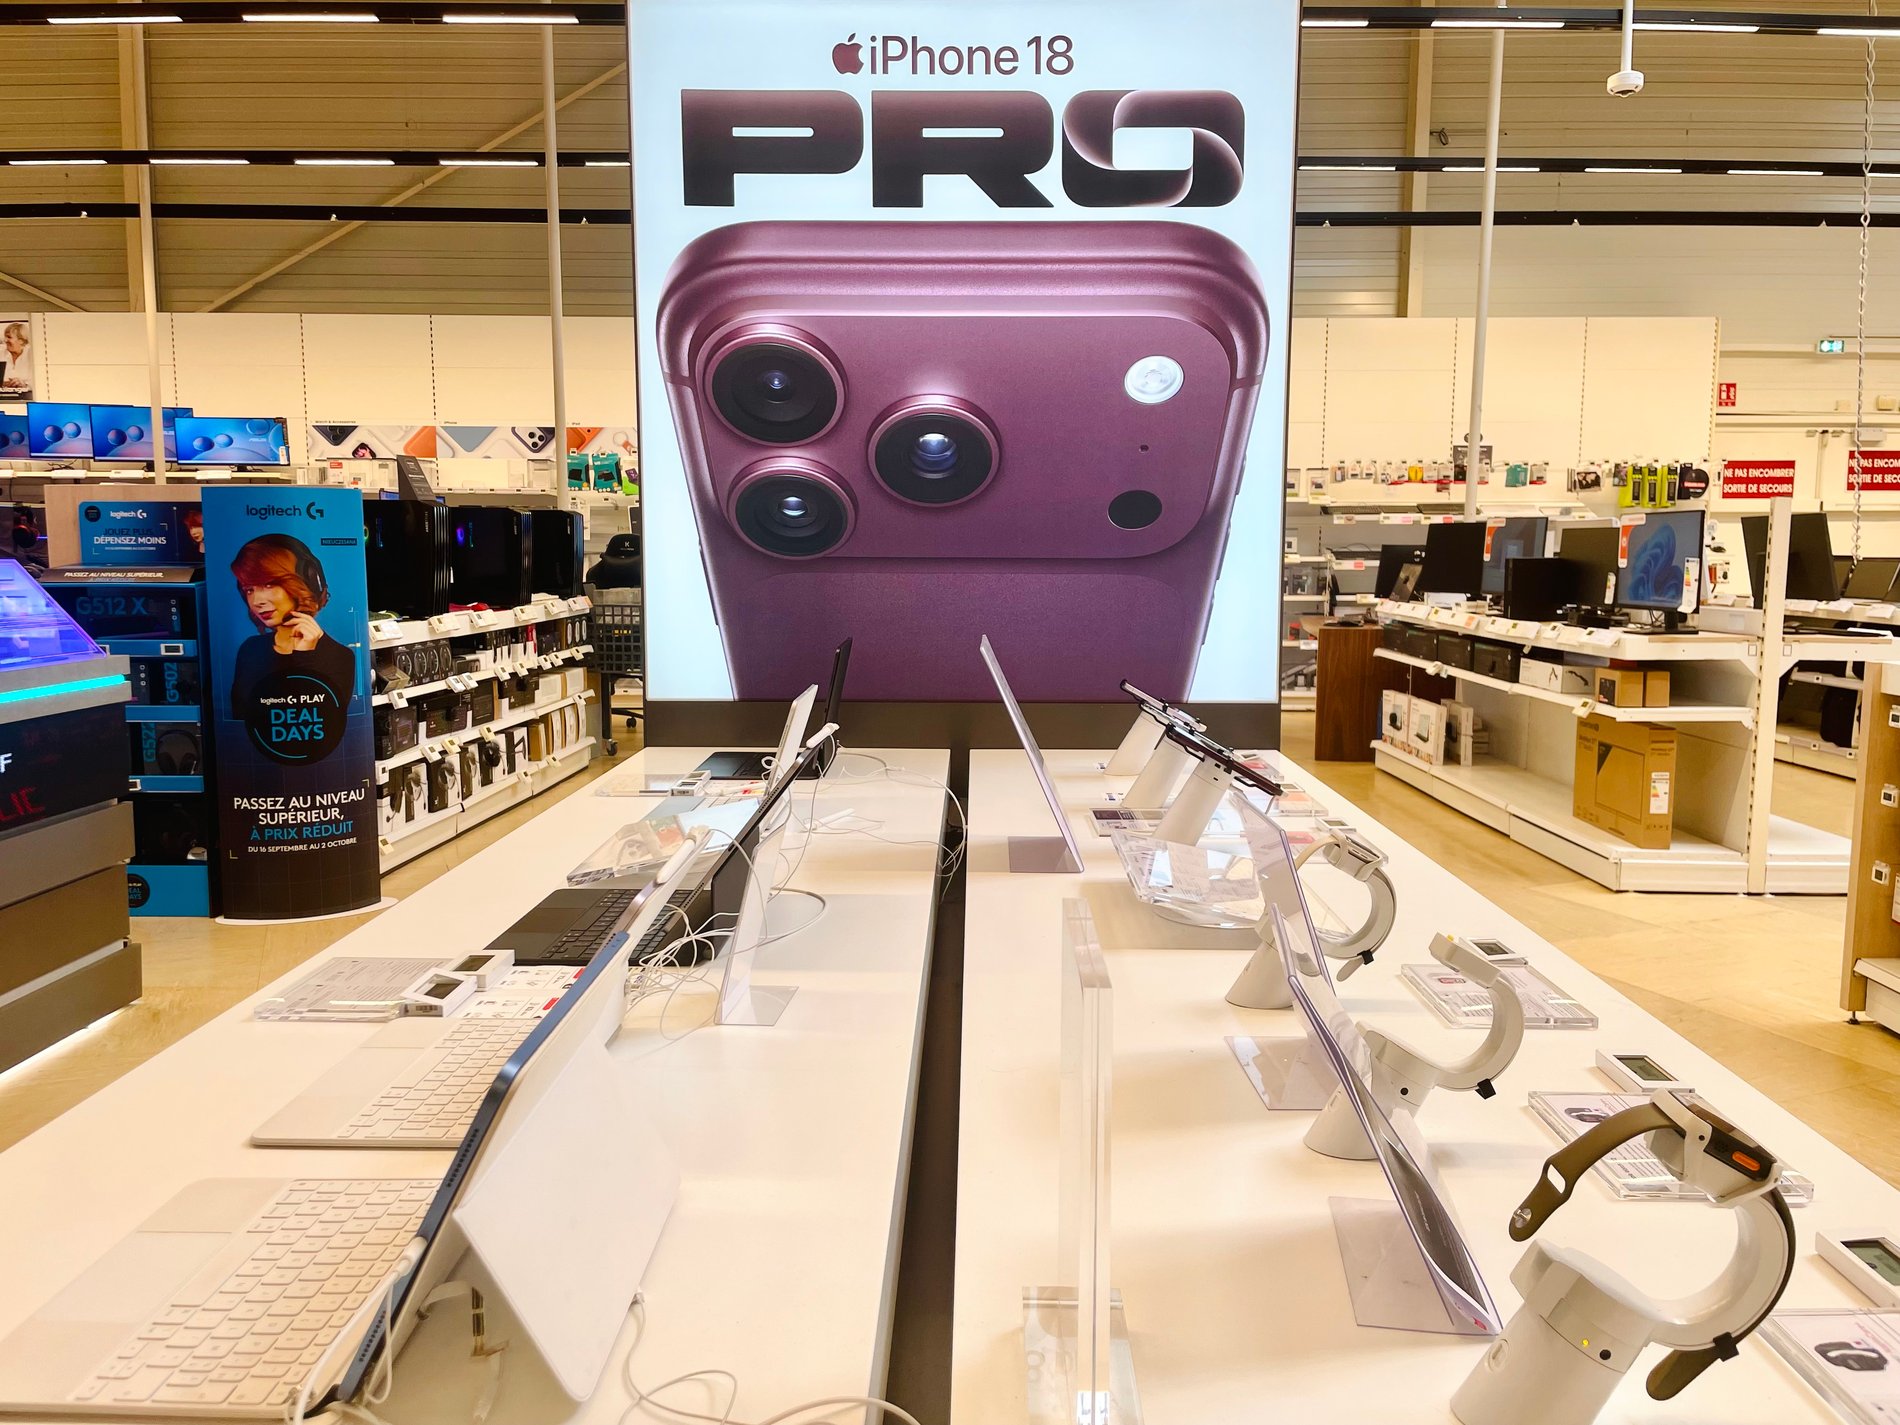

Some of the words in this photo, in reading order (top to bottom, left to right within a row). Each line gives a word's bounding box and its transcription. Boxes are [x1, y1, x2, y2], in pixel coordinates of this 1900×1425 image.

[869, 35, 1019, 76] iPhone
[1027, 34, 1075, 76] 18
[680, 88, 1246, 208] PRO
[1724, 468, 1733, 477] NE
[1734, 468, 1747, 477] PAS
[1748, 468, 1794, 477] ENCOMBRER
[1873, 474, 1882, 483] DE
[1723, 484, 1747, 493] SORTIE
[1748, 484, 1758, 493] DE
[1759, 484, 1793, 493] SECOURS
[110, 510, 136, 519] logitech
[246, 504, 302, 520] logitech
[94, 534, 136, 544] DÉPENSEZ
[138, 536, 166, 545] MOINS
[76, 596, 127, 616] G512
[130, 596, 149, 615] X
[164, 662, 180, 703] G502
[260, 697, 286, 706] logitech
[300, 694, 325, 704] PLAY
[270, 707, 324, 724] DEAL
[271, 724, 325, 742] DAYS
[233, 797, 286, 810] PASSEZ
[288, 795, 311, 809] AU
[316, 788, 365, 806] NIVEAU
[258, 807, 345, 825] SUPÉRIEUR,
[250, 825, 261, 841] À
[264, 827, 298, 841] PRIX
[302, 821, 354, 839] RÉDUIT
[267, 844, 308, 853] SEPTEMBRE
[327, 837, 358, 848] OCTOBRE
